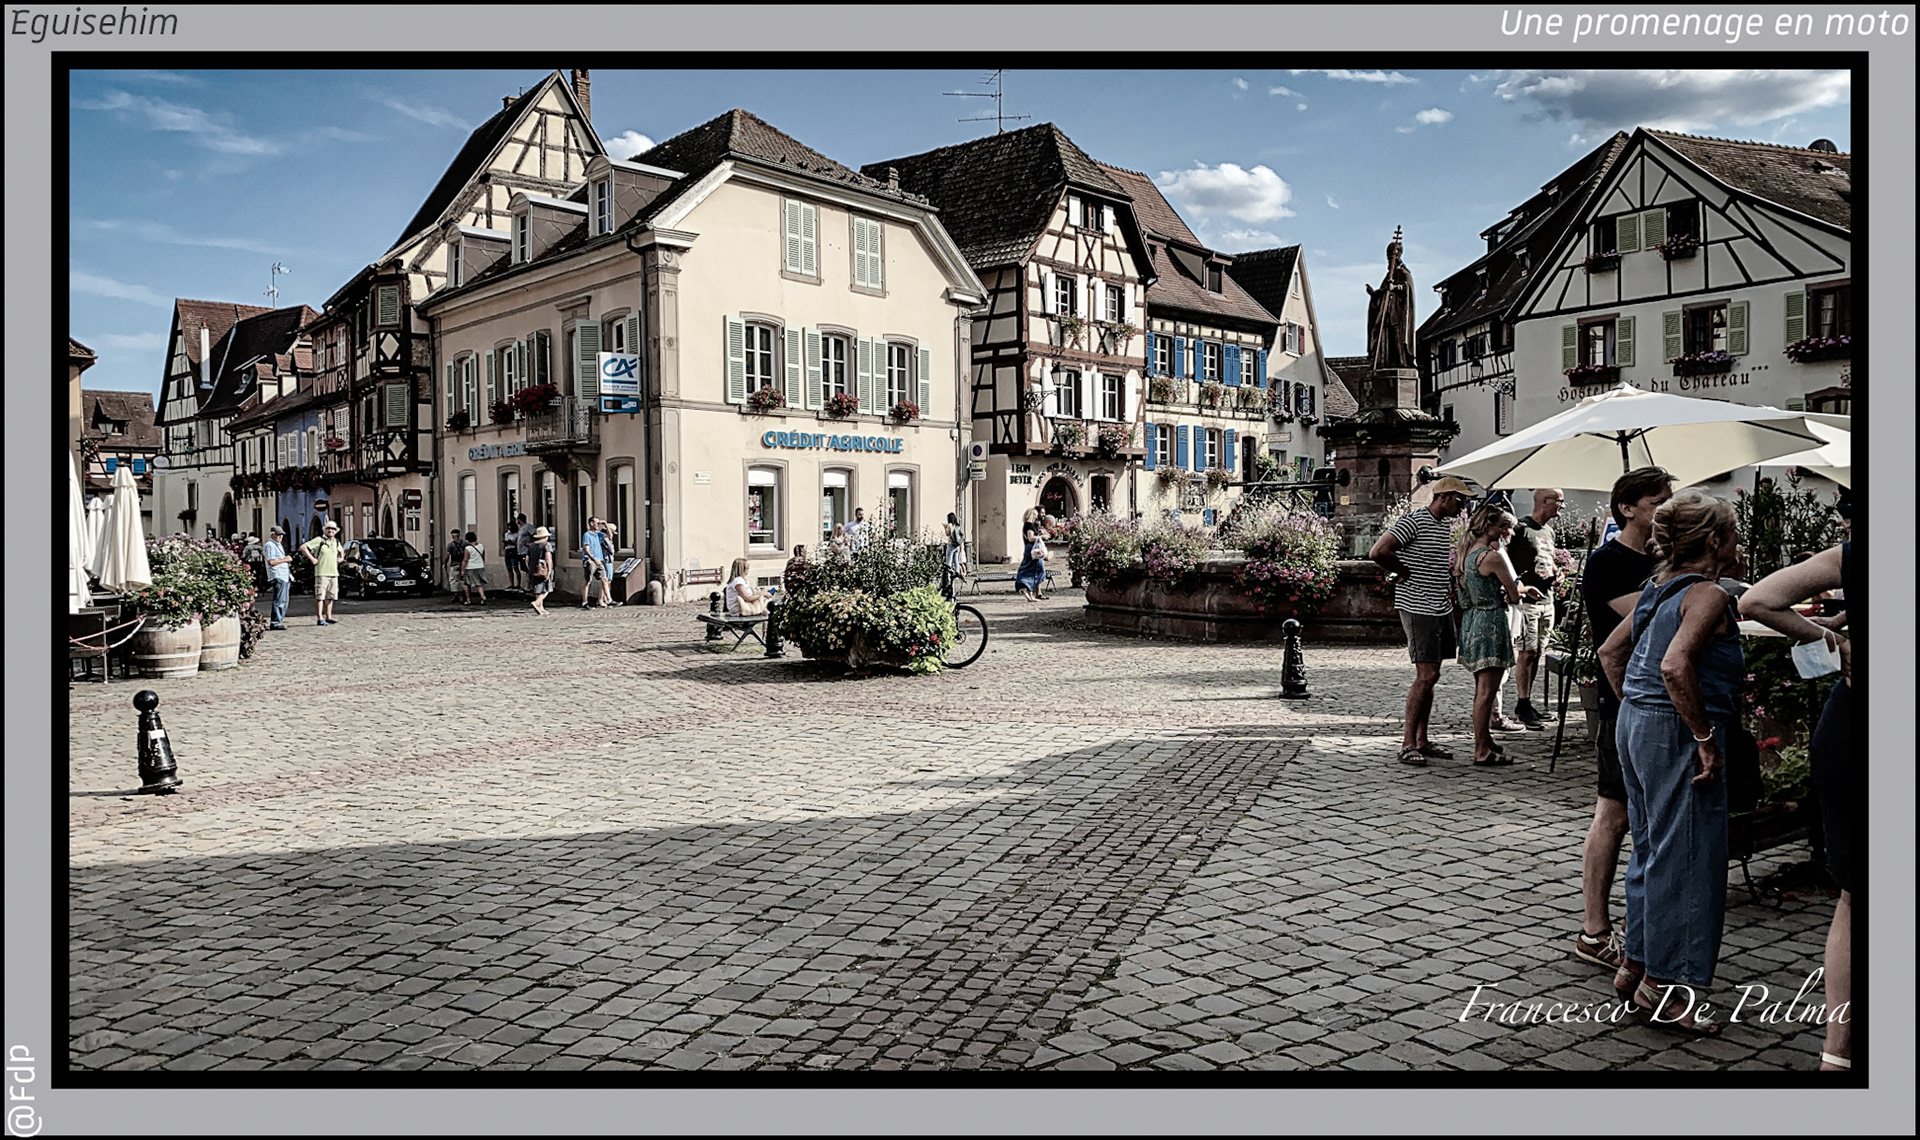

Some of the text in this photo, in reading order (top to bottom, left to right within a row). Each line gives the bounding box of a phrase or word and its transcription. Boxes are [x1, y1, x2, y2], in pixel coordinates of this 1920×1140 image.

[1650, 377, 1669, 393] du
[762, 429, 905, 453] CRÉDIT AGRICOLE
